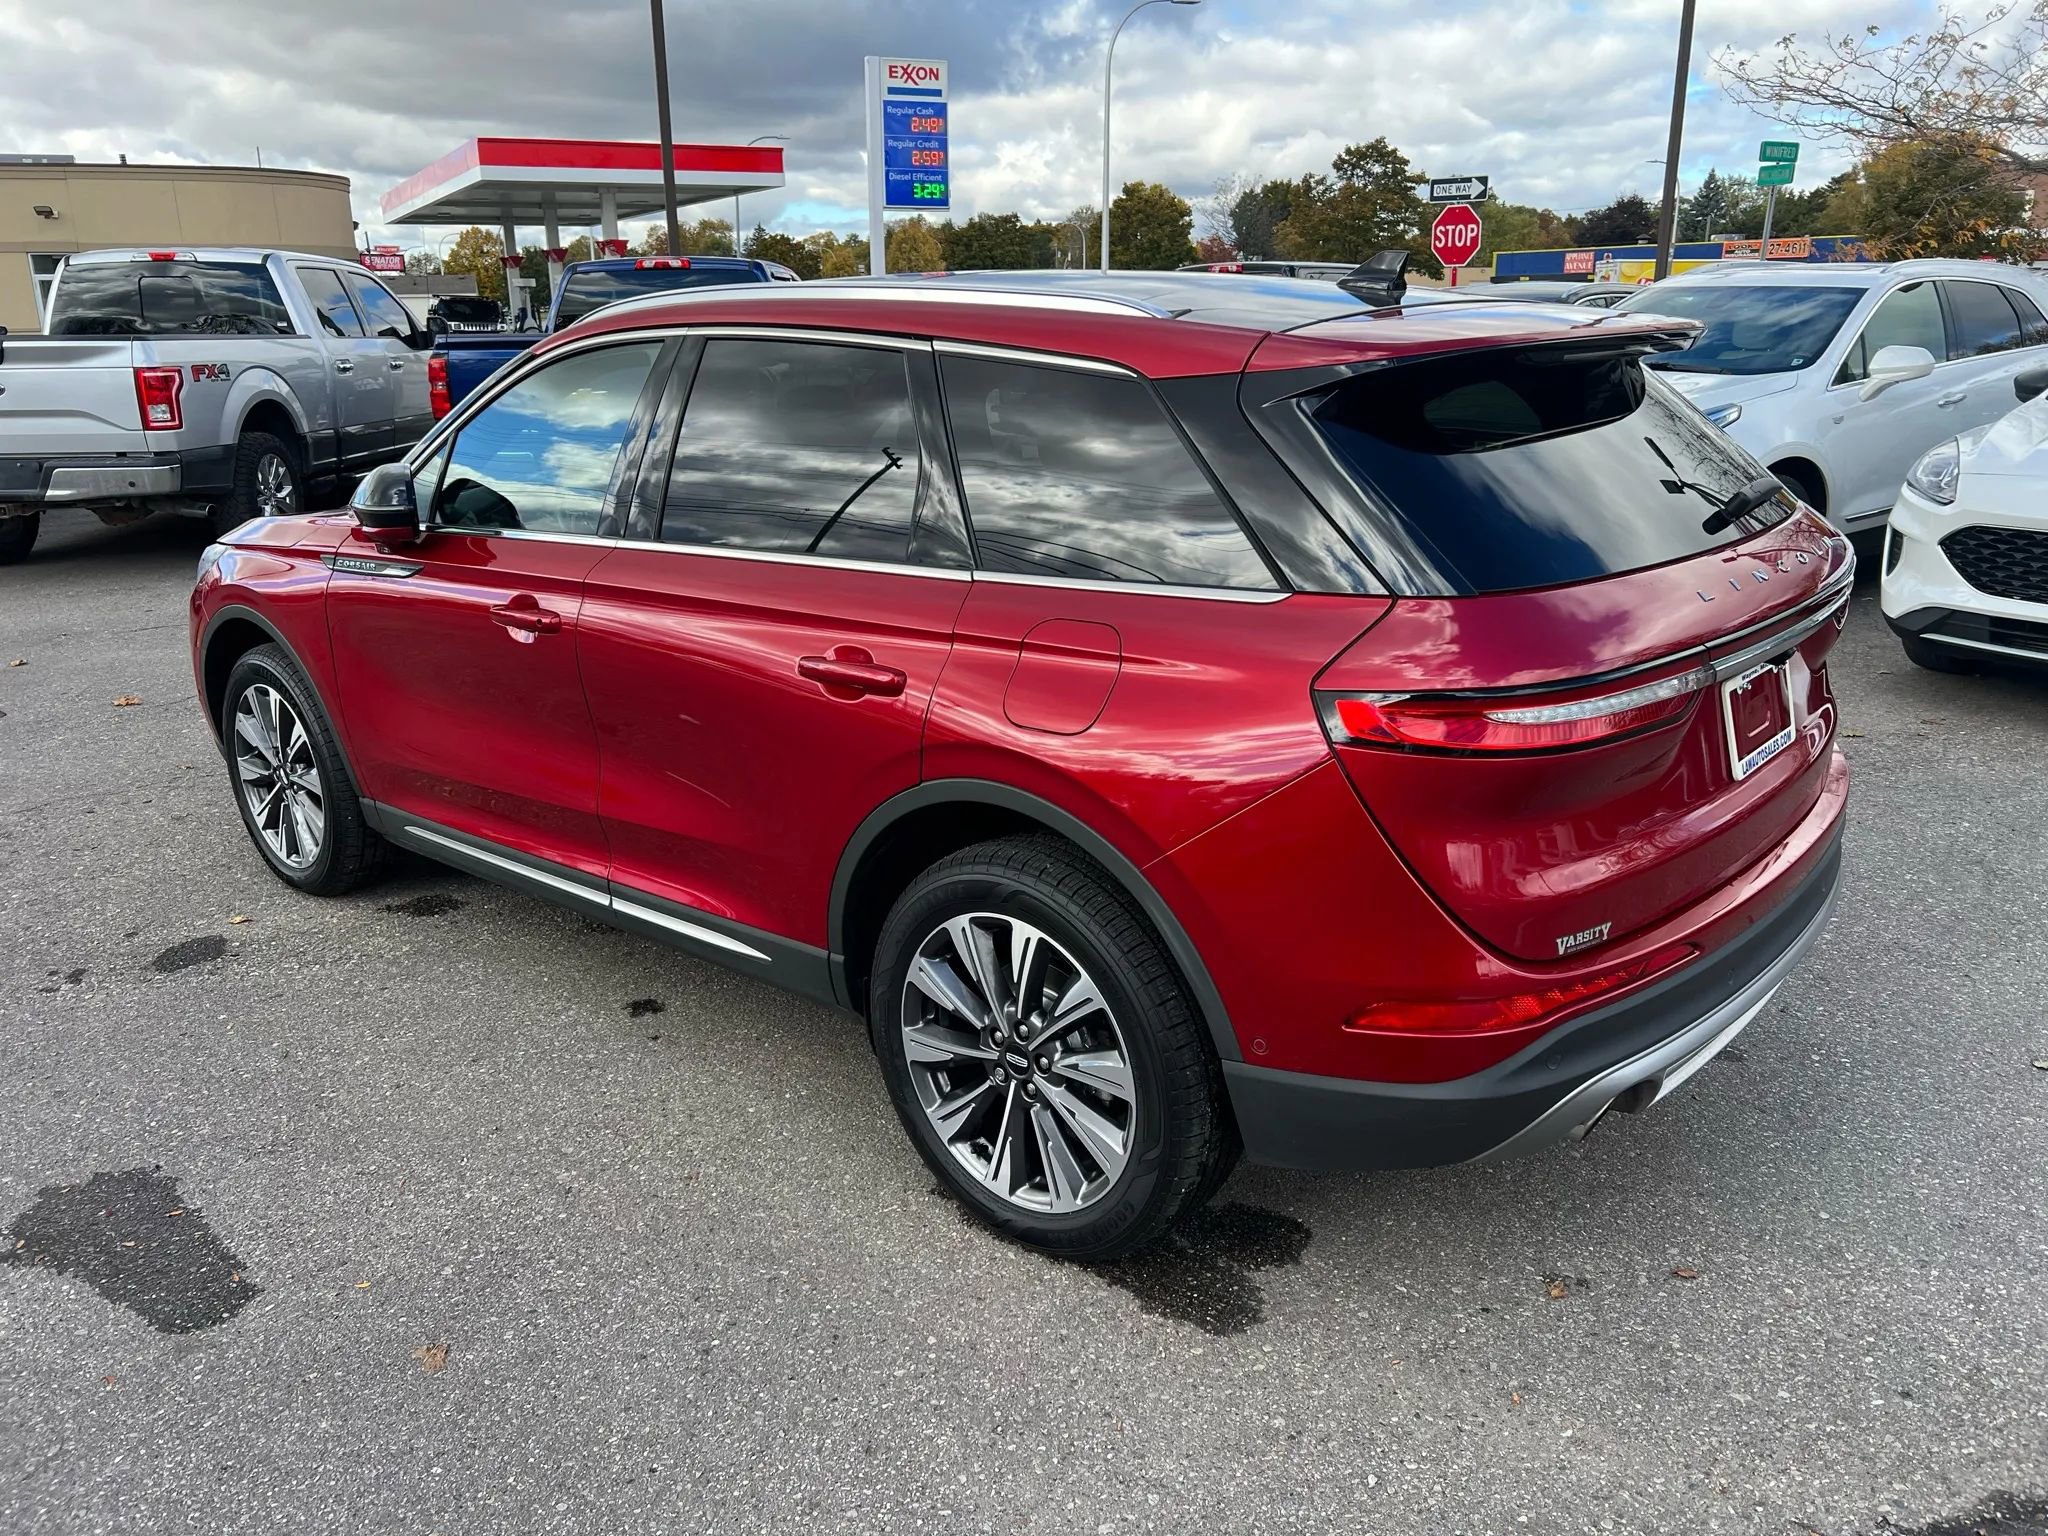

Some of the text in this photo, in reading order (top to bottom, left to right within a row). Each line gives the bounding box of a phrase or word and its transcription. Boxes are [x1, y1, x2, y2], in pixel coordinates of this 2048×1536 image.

[888, 64, 939, 86] EXXON
[887, 105, 934, 116] Regular Cash
[887, 139, 939, 149] Regular Credit
[888, 172, 942, 181] Diesel Efficient
[1435, 183, 1472, 195] ONE WAY
[1435, 224, 1478, 248] STOP
[364, 256, 400, 265] SENATOR
[1565, 262, 1593, 270] AVENUE
[190, 363, 230, 382] FX4
[337, 560, 376, 570] CORSAIR
[1696, 535, 1834, 603] LINCOLN
[1741, 730, 1793, 776] LAWAUTOSALES.COM
[1556, 922, 1612, 955] VARSITY
